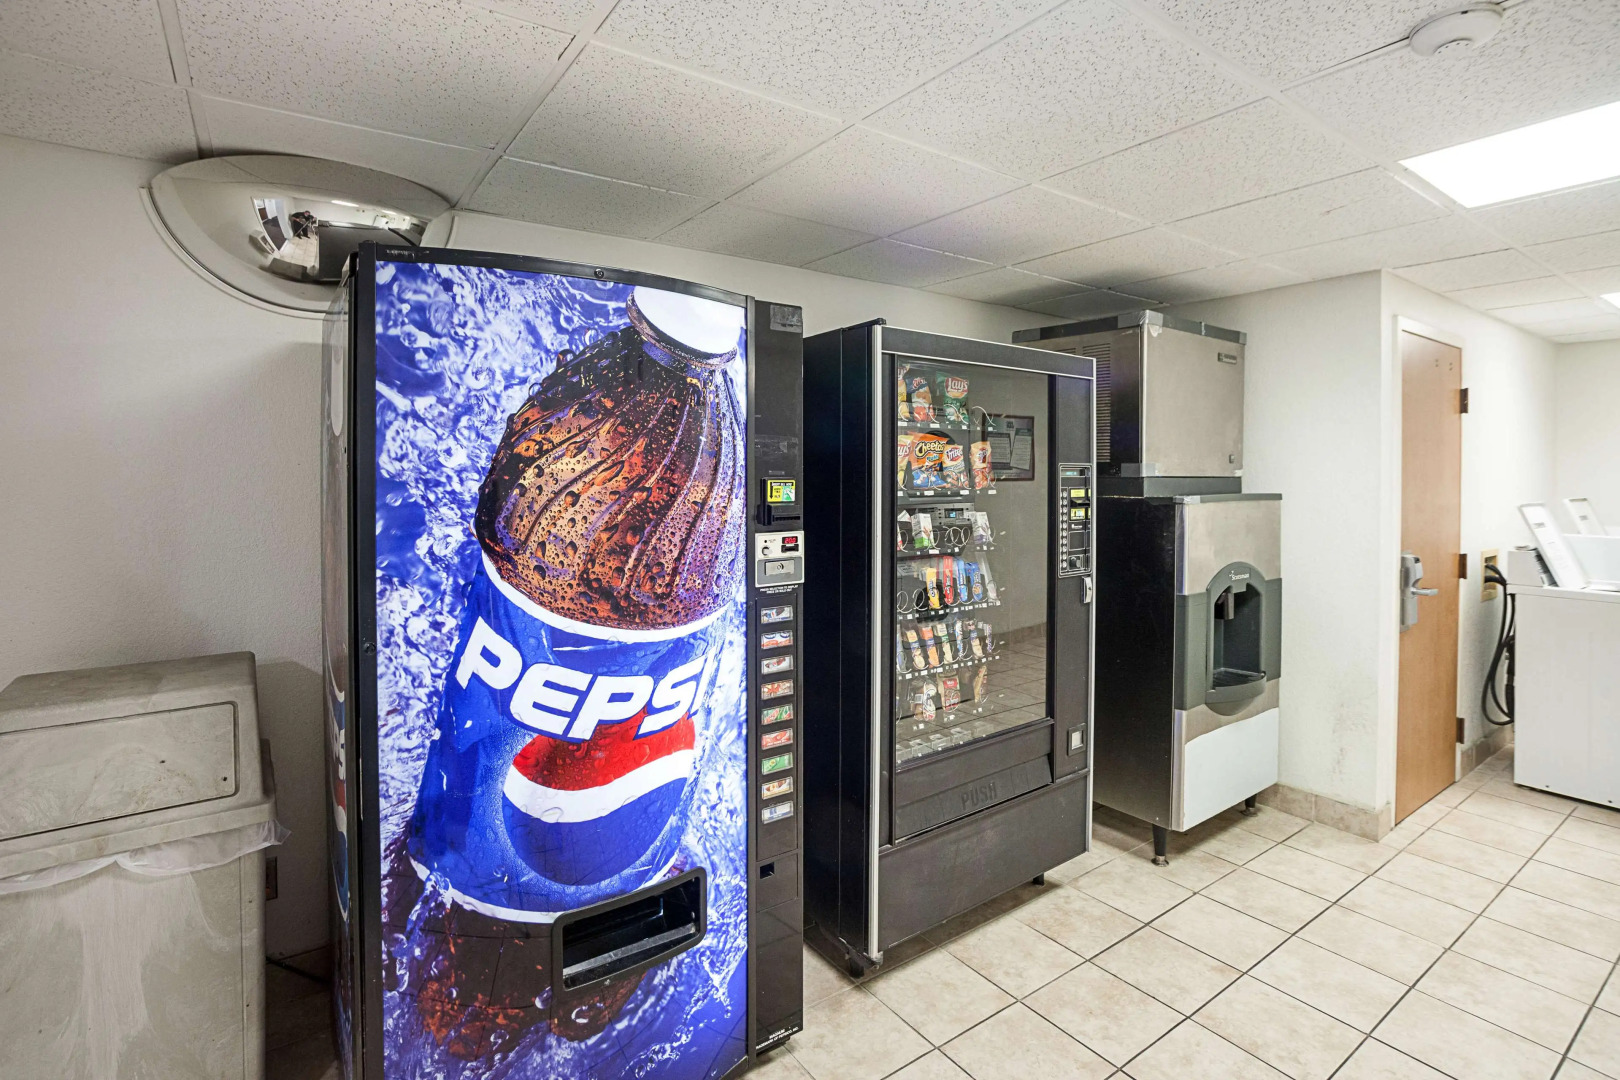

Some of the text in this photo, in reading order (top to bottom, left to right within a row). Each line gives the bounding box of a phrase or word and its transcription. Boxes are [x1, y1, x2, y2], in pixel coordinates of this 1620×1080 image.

[948, 377, 968, 392] Lay's
[915, 440, 945, 458] Cheetos
[455, 616, 716, 740] PEPSI
[960, 781, 998, 811] PUSH
